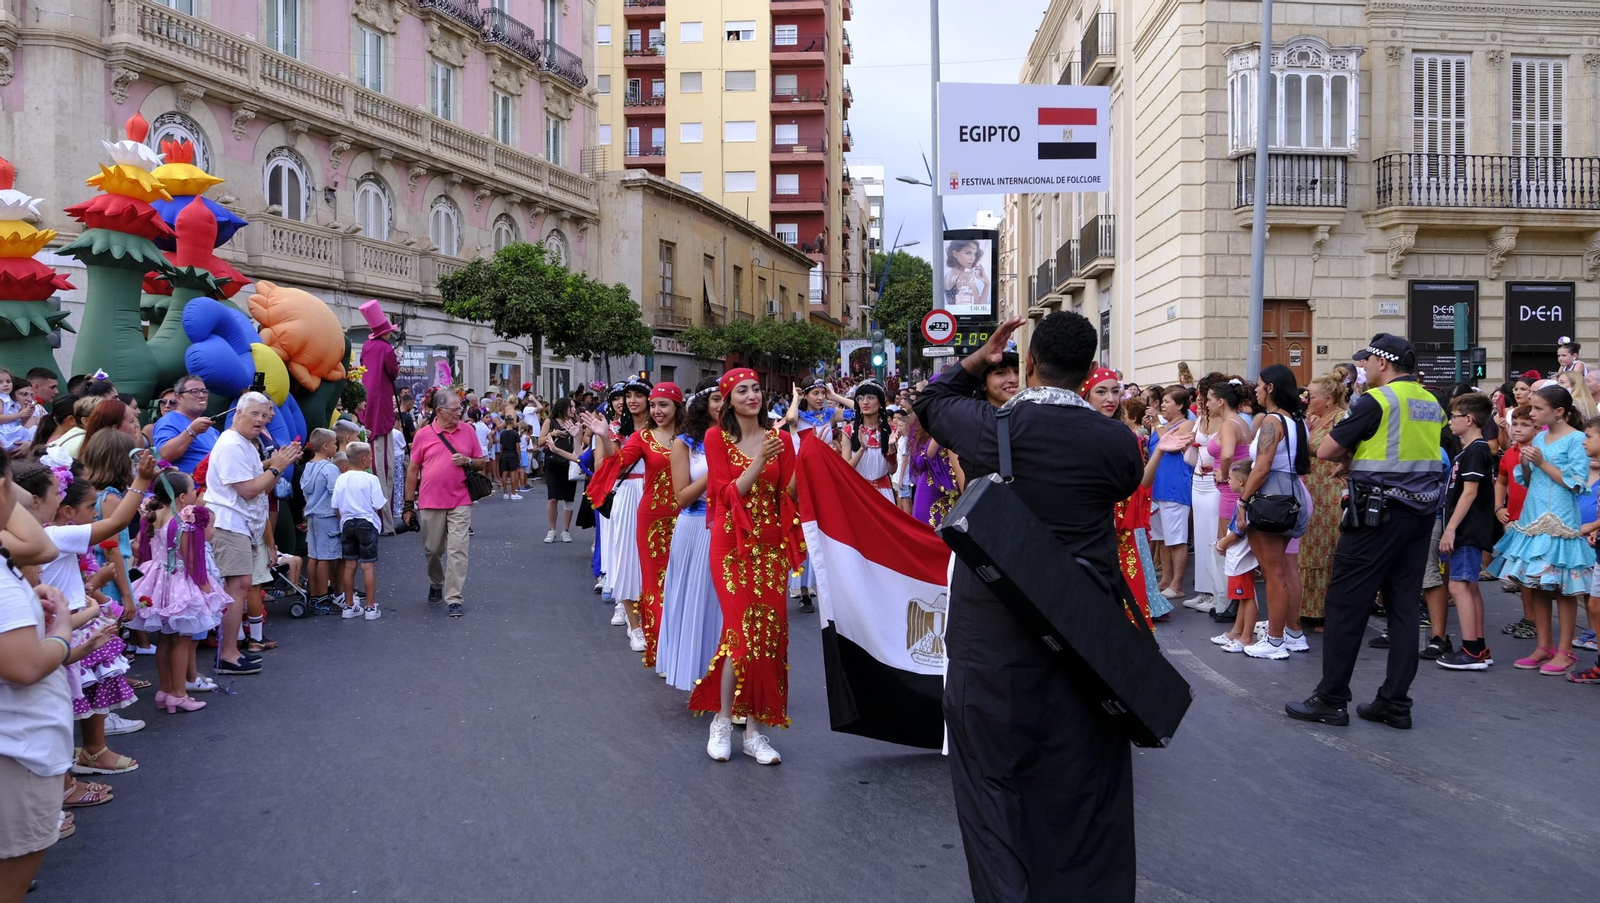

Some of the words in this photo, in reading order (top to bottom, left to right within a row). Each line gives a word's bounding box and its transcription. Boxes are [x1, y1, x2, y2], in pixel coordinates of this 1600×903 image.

[959, 125, 1021, 142] EGIPTO
[961, 178, 995, 186] FESTIVAL
[997, 176, 1054, 185] INTERNACIONAL
[1056, 176, 1066, 184] DE
[1067, 175, 1101, 183] FOLCLORE
[1319, 345, 1326, 354] 6
[399, 359, 420, 367] LMERÍA
[1413, 411, 1443, 421] LOCAL
